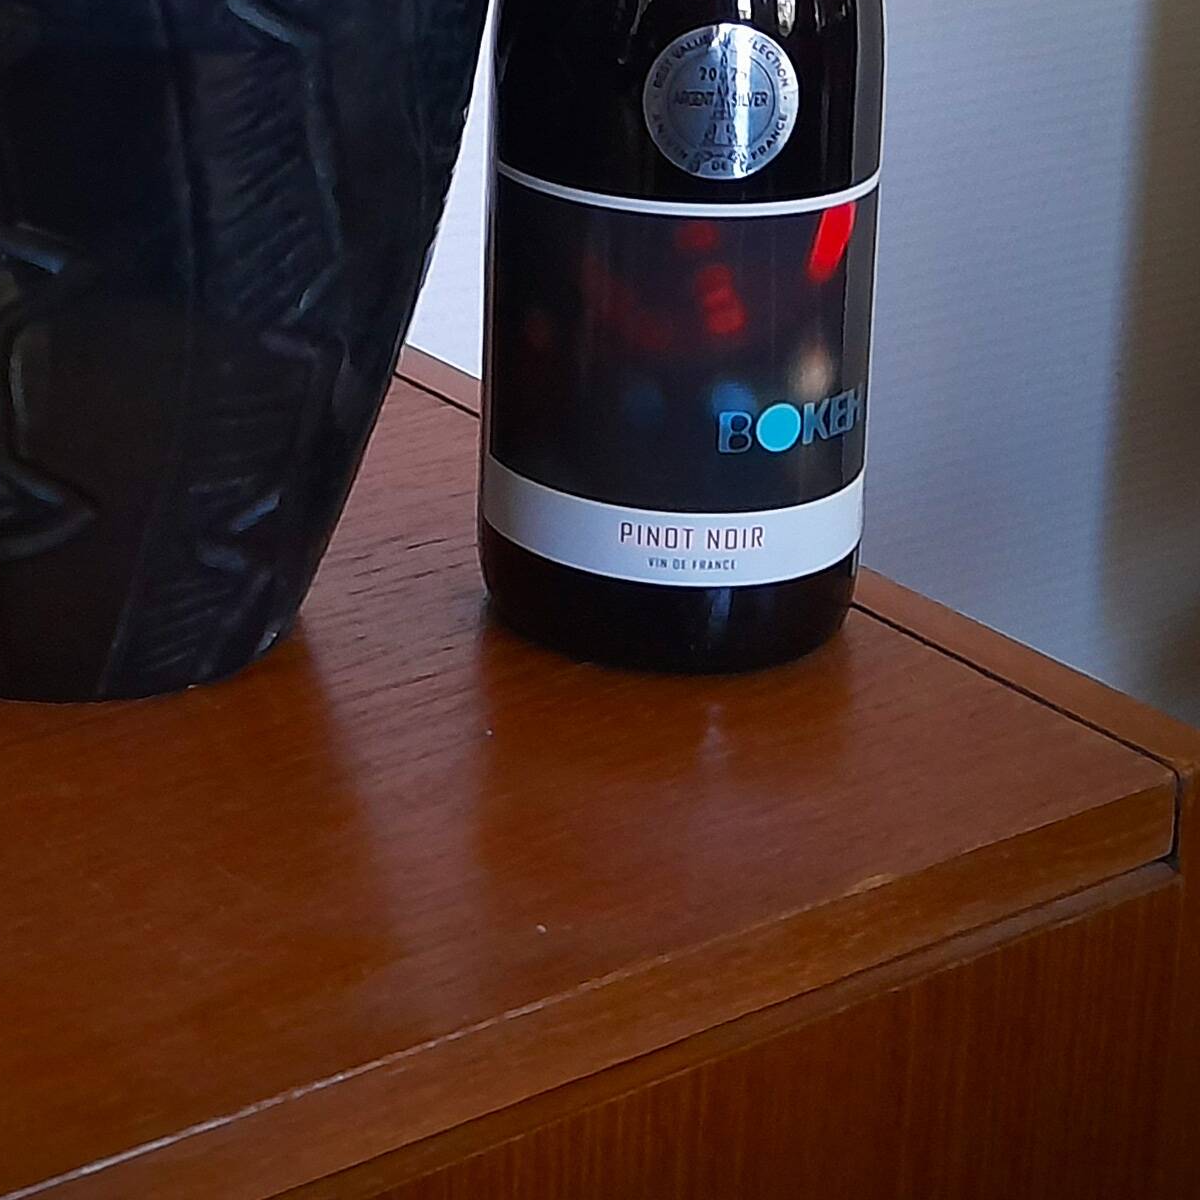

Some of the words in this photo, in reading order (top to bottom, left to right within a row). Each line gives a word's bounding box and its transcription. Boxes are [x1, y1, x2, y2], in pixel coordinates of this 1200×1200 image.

[732, 90, 768, 108] SILVER
[750, 114, 788, 161] FRANCE
[620, 521, 694, 550] PINOT
[707, 526, 764, 551] NOIR
[648, 557, 667, 569] VIN
[672, 558, 686, 570] DE
[692, 558, 736, 571] FRANCE
